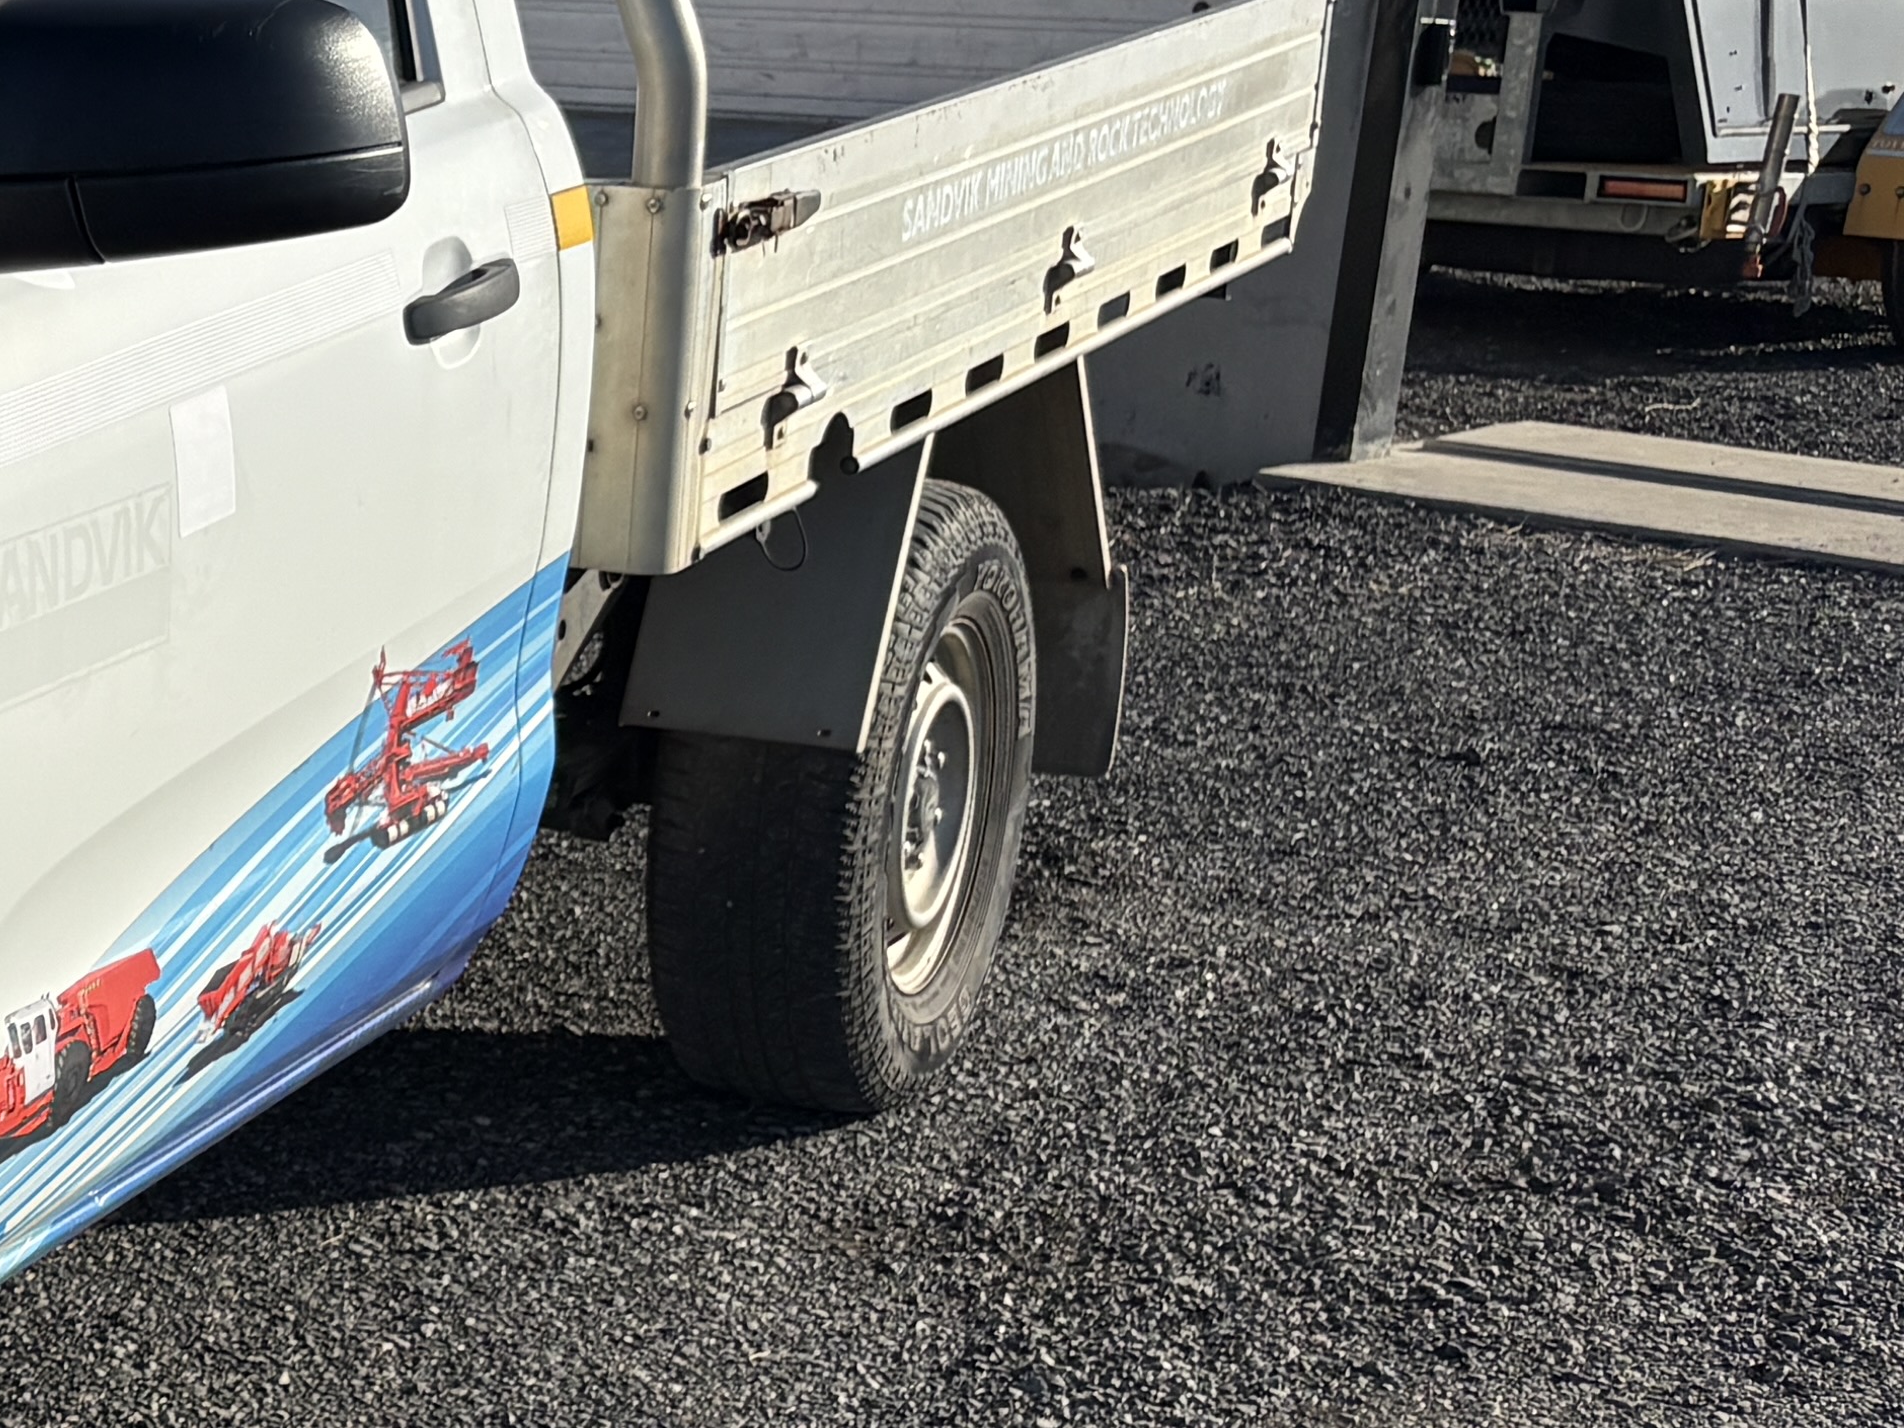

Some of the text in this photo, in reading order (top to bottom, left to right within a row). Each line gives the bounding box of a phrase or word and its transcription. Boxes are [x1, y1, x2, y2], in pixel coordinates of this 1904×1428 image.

[902, 169, 983, 242] SANDVIK
[985, 144, 1050, 209] MINING
[1087, 114, 1131, 166] ROCK
[1131, 79, 1228, 149] TECHNOLOGY
